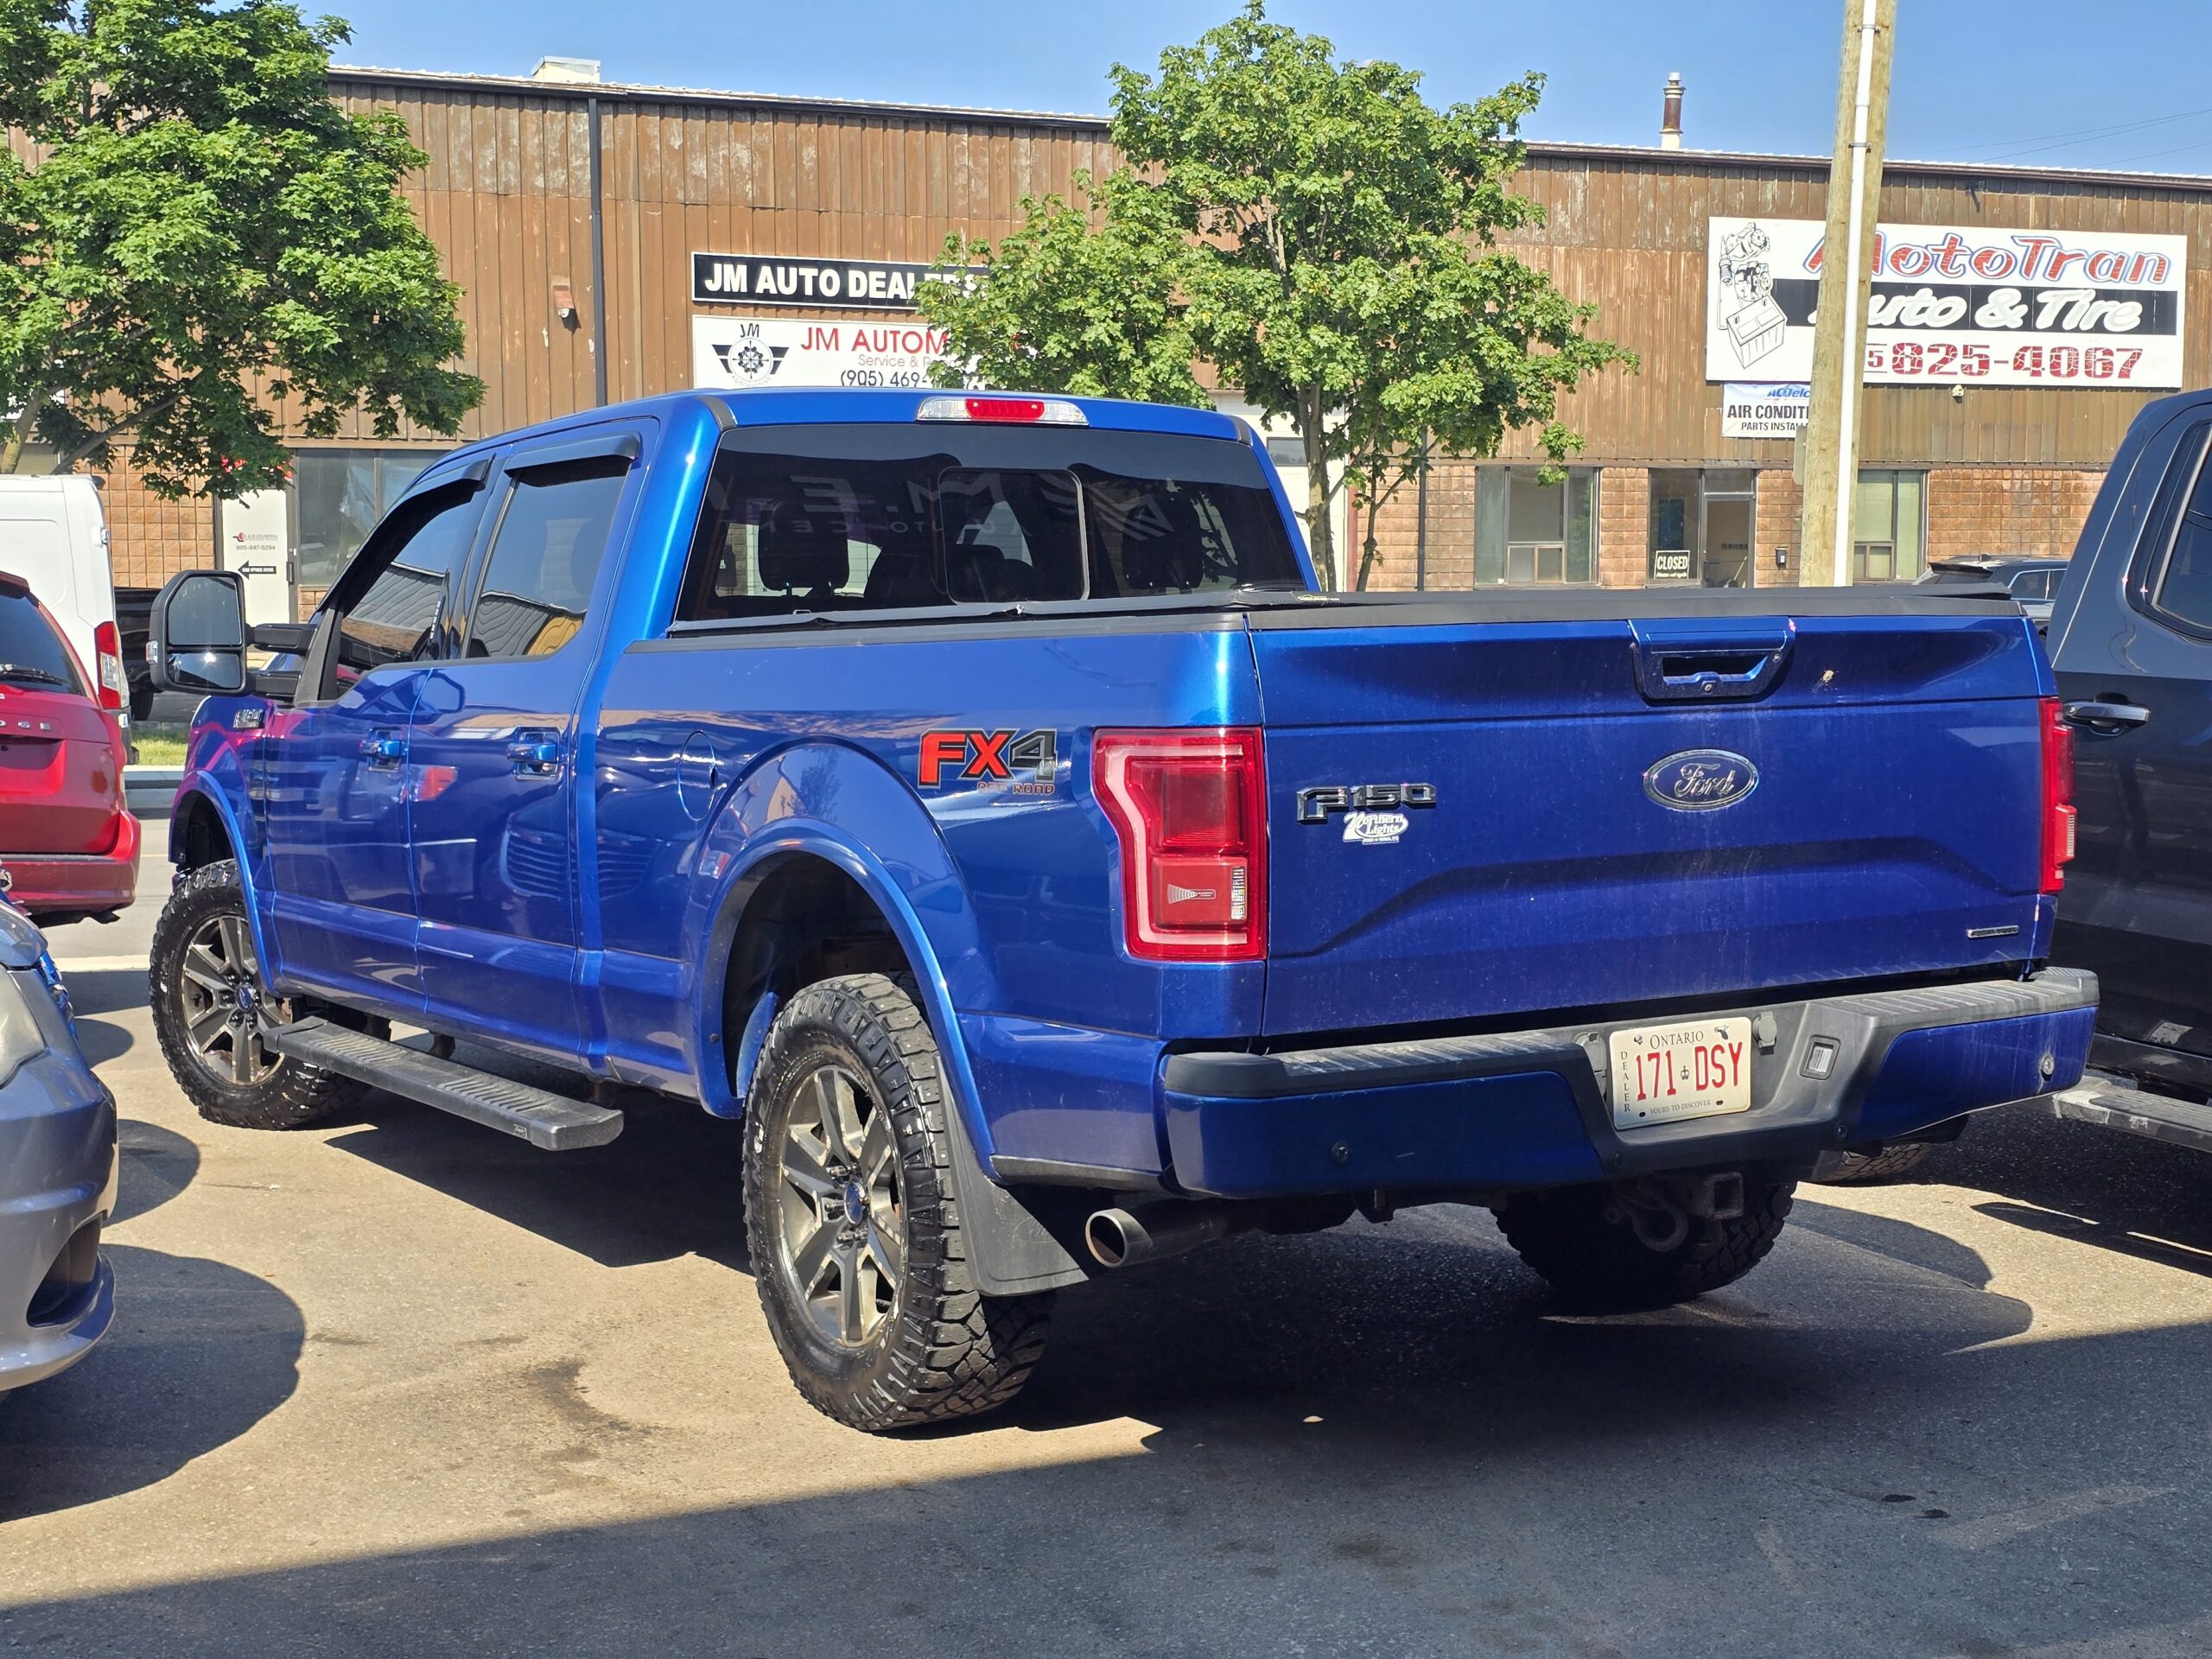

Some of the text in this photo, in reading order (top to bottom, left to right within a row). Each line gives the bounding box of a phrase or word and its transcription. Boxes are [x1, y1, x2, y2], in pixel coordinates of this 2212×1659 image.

[1802, 231, 2171, 284] otoTran
[704, 263, 747, 292] JM
[755, 265, 841, 296] AUTO
[1808, 288, 2143, 332] uto & Tire
[740, 323, 760, 338] JM
[801, 327, 948, 354] JM AUTOM
[858, 354, 906, 366] Service
[910, 356, 918, 367] &
[1892, 343, 2143, 378] 825-4067
[841, 370, 927, 388] (905) 469-
[1767, 388, 1811, 397] ACDelc
[1727, 405, 1809, 419] AIR CONDITI
[1741, 422, 1769, 430] PARTS
[1656, 556, 1688, 569] CLOSED
[918, 728, 1058, 789] FX4
[977, 782, 1055, 795] OFF ROAD
[1674, 763, 1736, 798] Ford
[1650, 1031, 1704, 1049] ONTARIO
[1636, 1042, 1743, 1101] 171 DSY
[1620, 1051, 1631, 1112] DEALER
[1649, 1106, 1669, 1115] YOURS
[1681, 1100, 1712, 1110] DISCOVER
